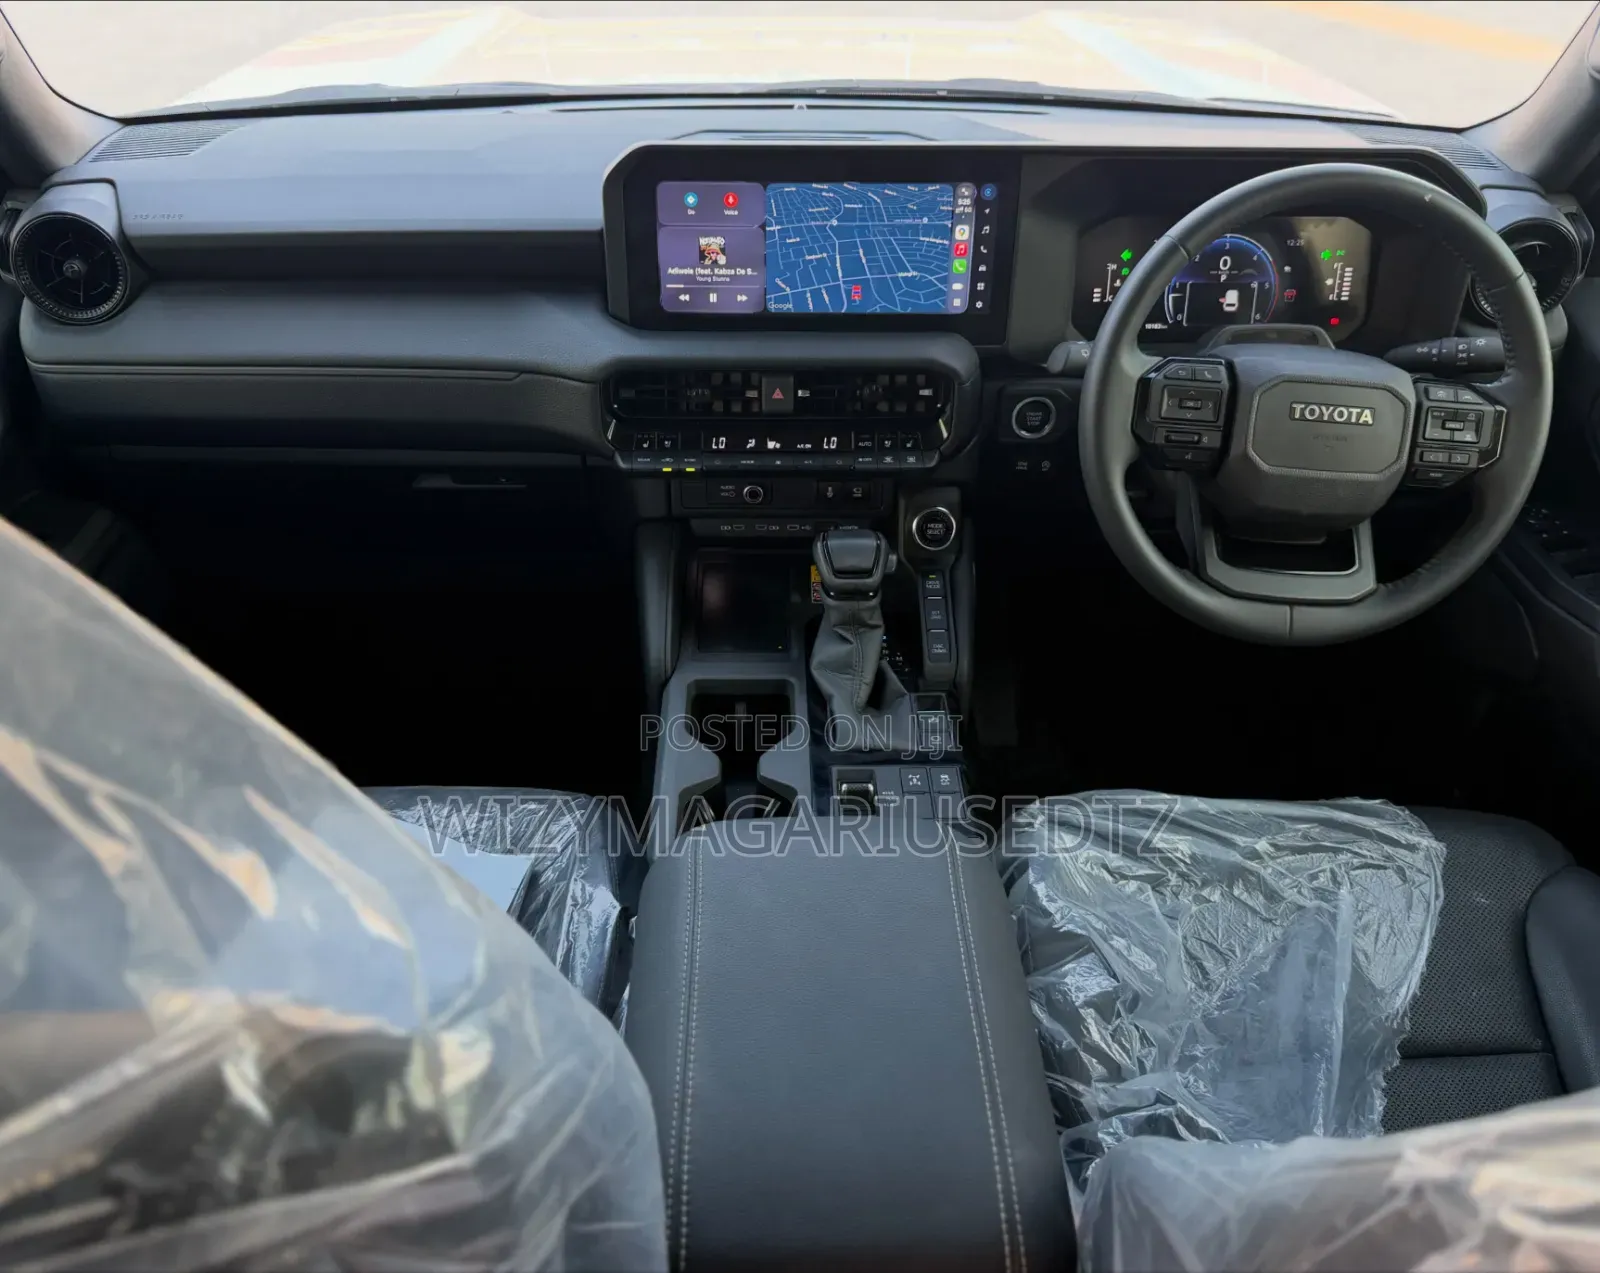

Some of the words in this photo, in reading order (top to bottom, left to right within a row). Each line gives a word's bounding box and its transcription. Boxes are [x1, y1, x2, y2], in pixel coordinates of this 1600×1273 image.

[1219, 255, 1231, 271] 0
[714, 267, 735, 275] Kabza
[1220, 274, 1227, 282] P
[768, 301, 793, 311] Google
[1291, 403, 1373, 425] TOYOTA
[711, 437, 726, 449] LO
[823, 436, 837, 449] LO
